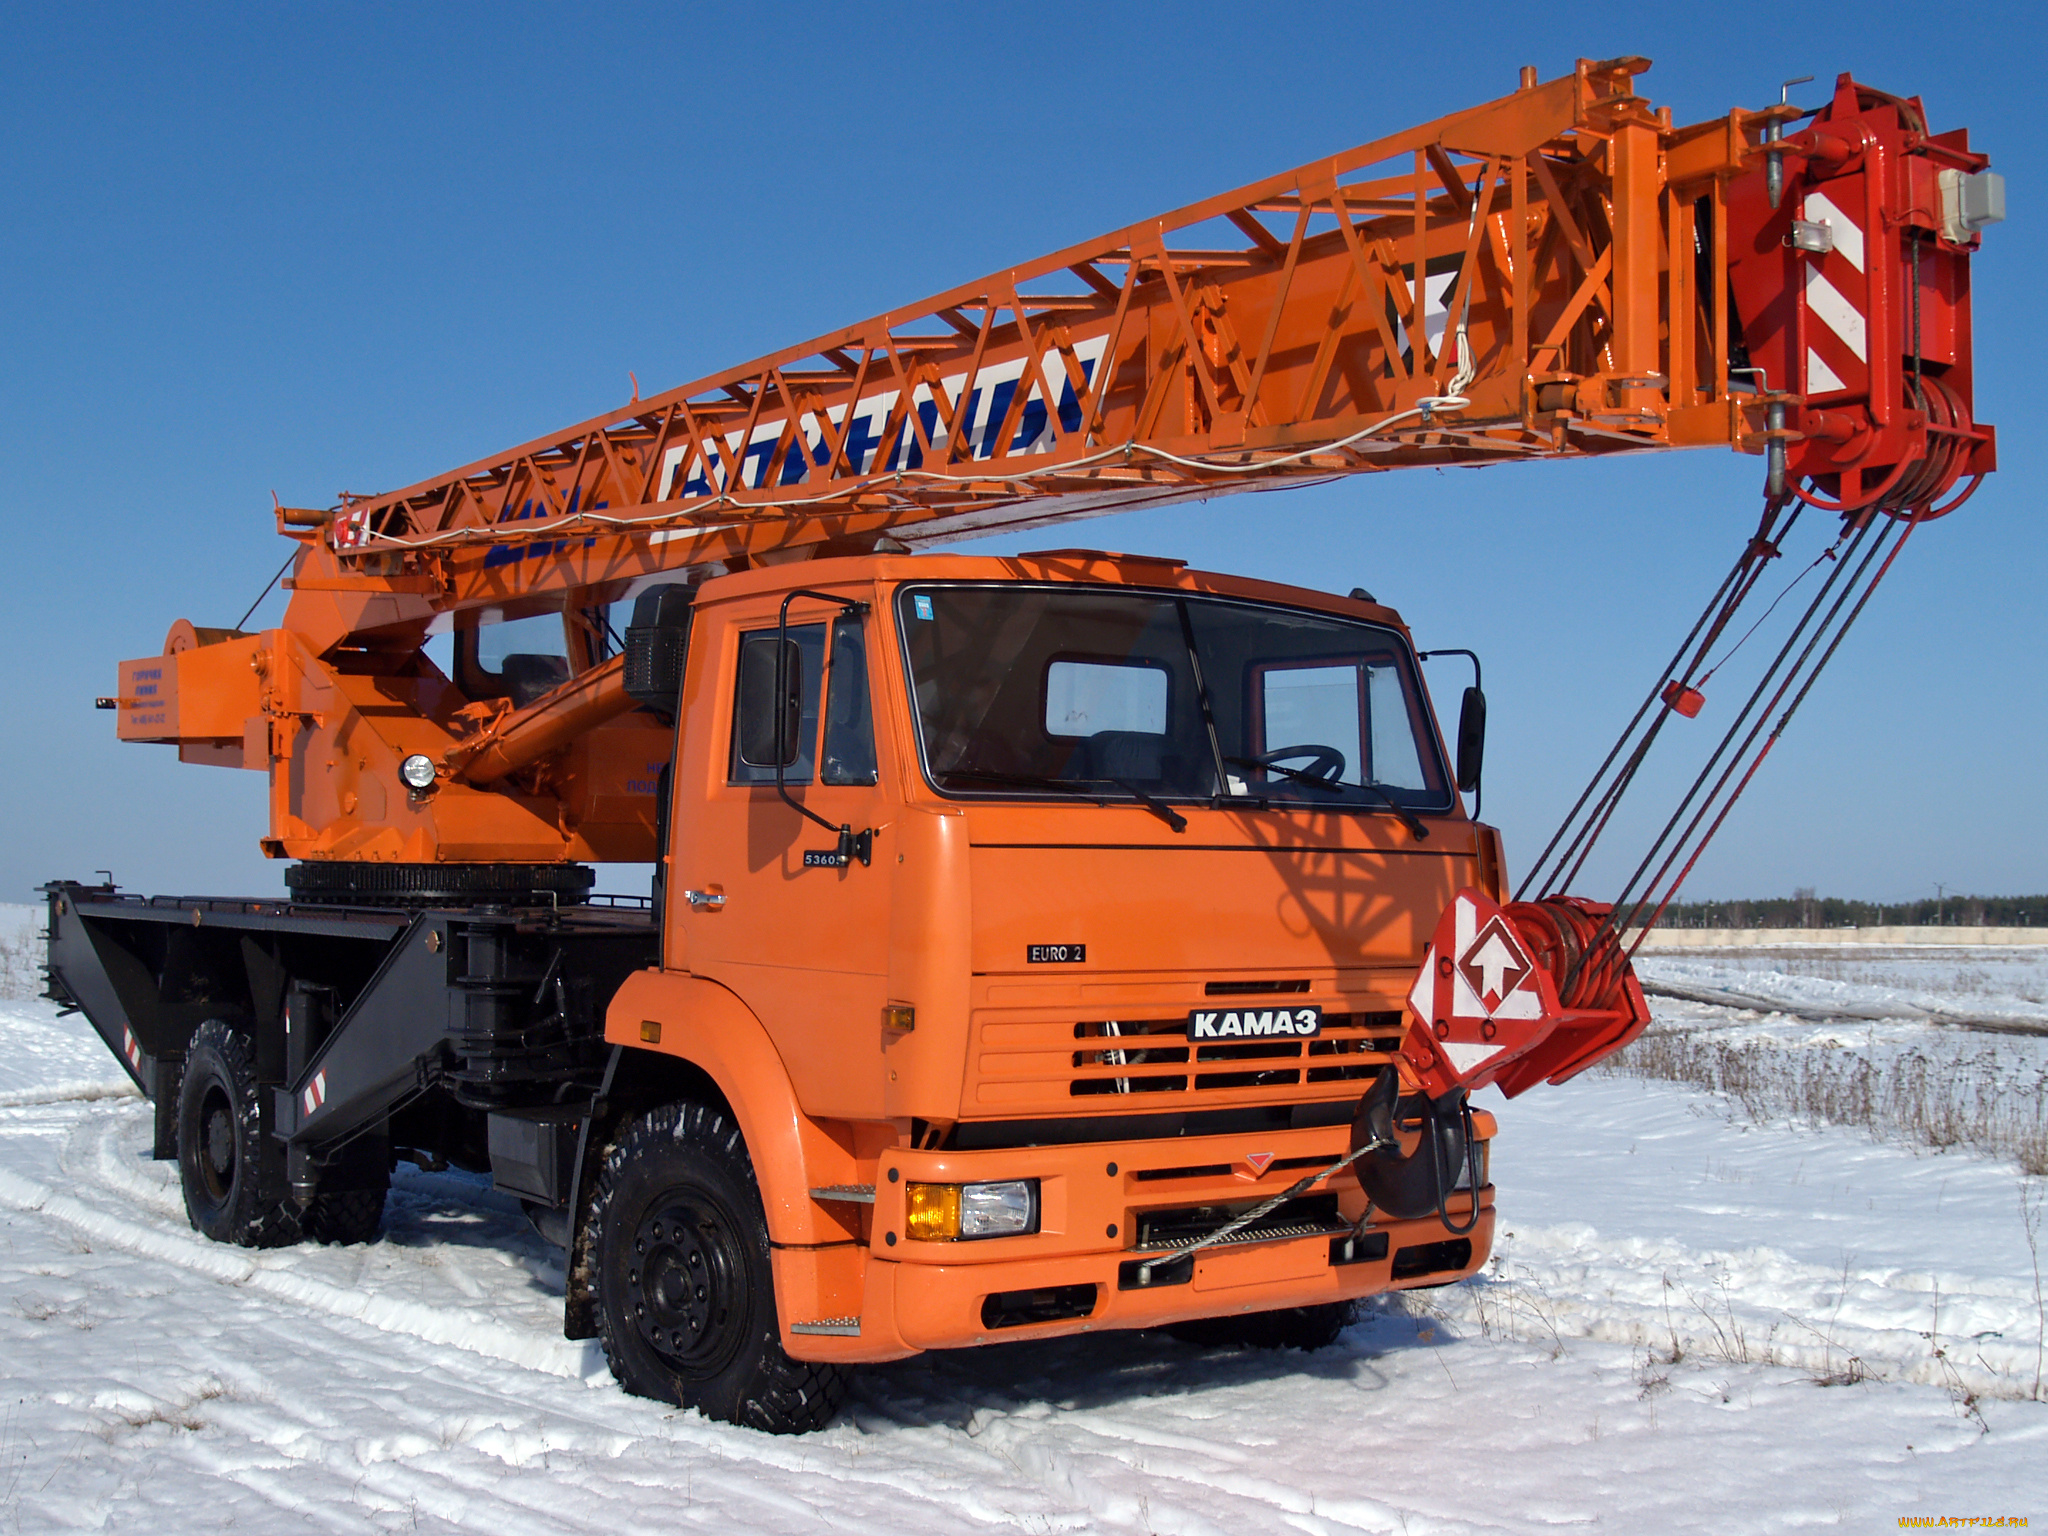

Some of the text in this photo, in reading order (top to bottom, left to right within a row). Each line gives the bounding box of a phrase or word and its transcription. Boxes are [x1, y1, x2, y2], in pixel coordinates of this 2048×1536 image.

[1032, 945, 1082, 961] EURO 2
[1194, 1009, 1317, 1038] КАМАЗ
